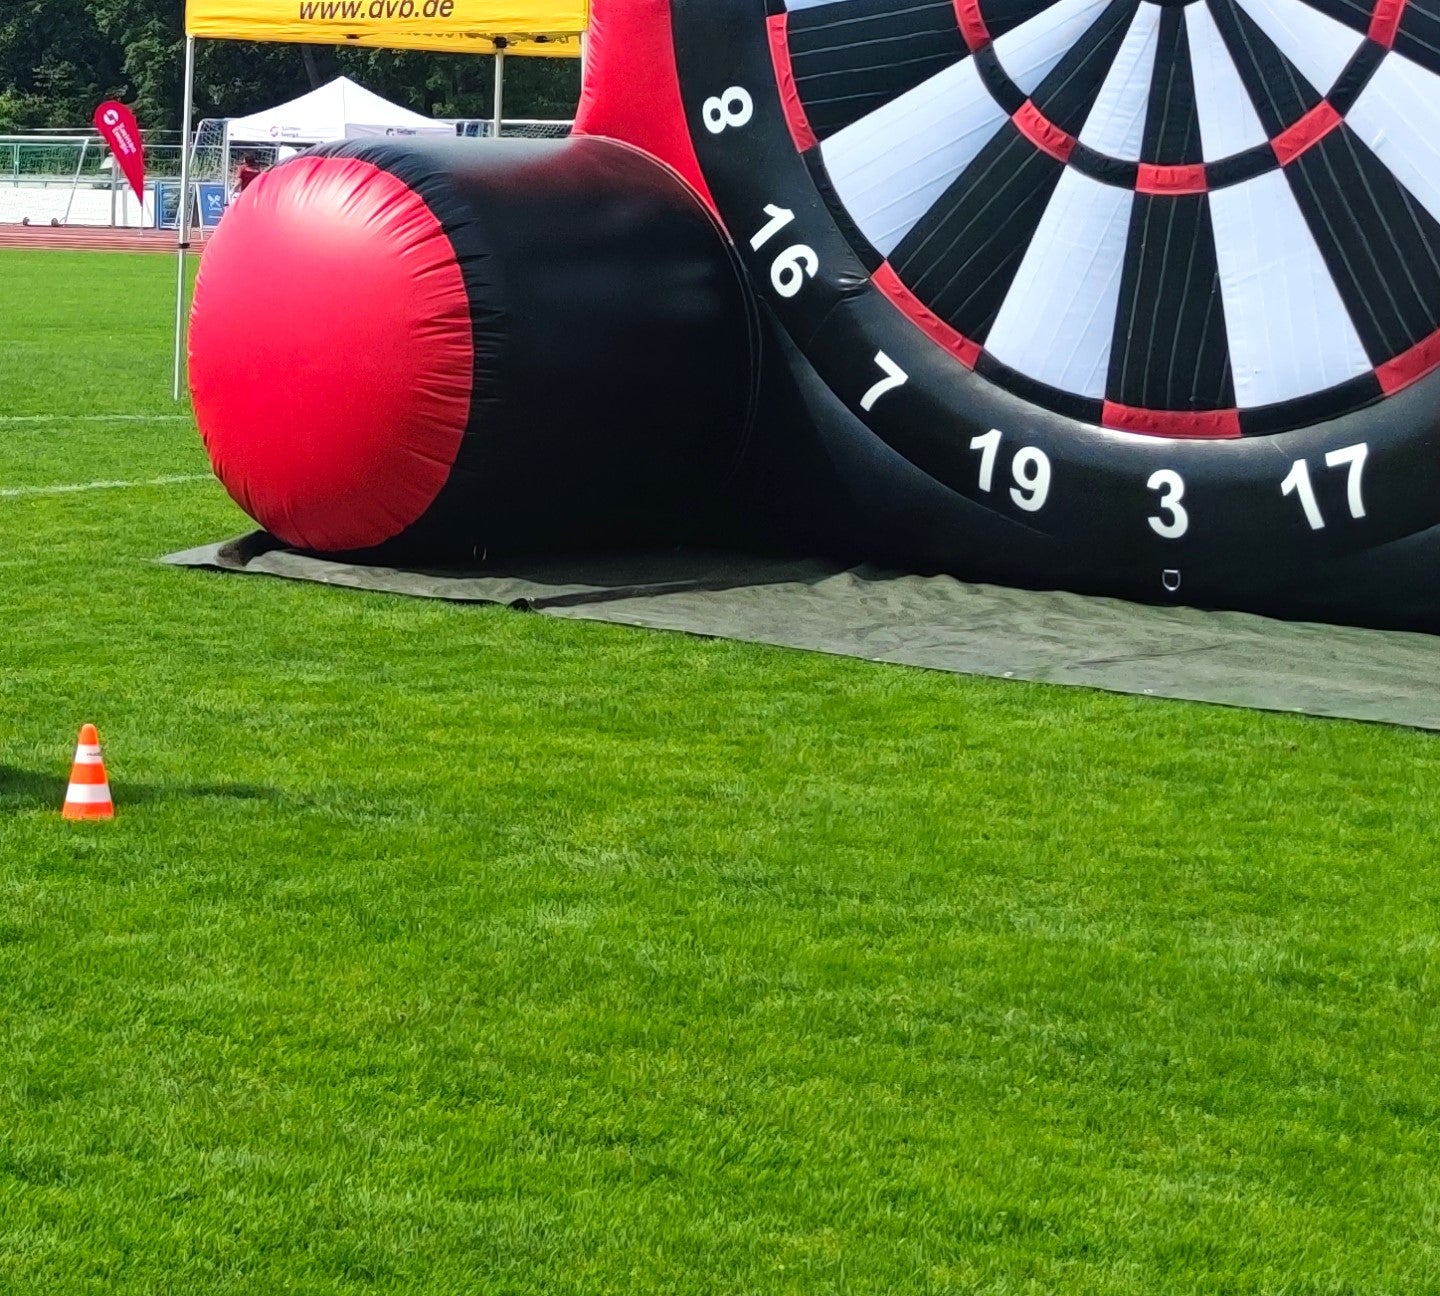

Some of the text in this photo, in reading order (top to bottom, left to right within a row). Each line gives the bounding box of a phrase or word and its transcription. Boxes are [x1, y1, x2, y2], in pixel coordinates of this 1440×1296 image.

[703, 86, 755, 134] 8
[750, 204, 819, 298] 16
[860, 350, 909, 412] 7
[969, 429, 1052, 512] 19
[1147, 469, 1189, 539] 3
[1281, 442, 1369, 530] 17
